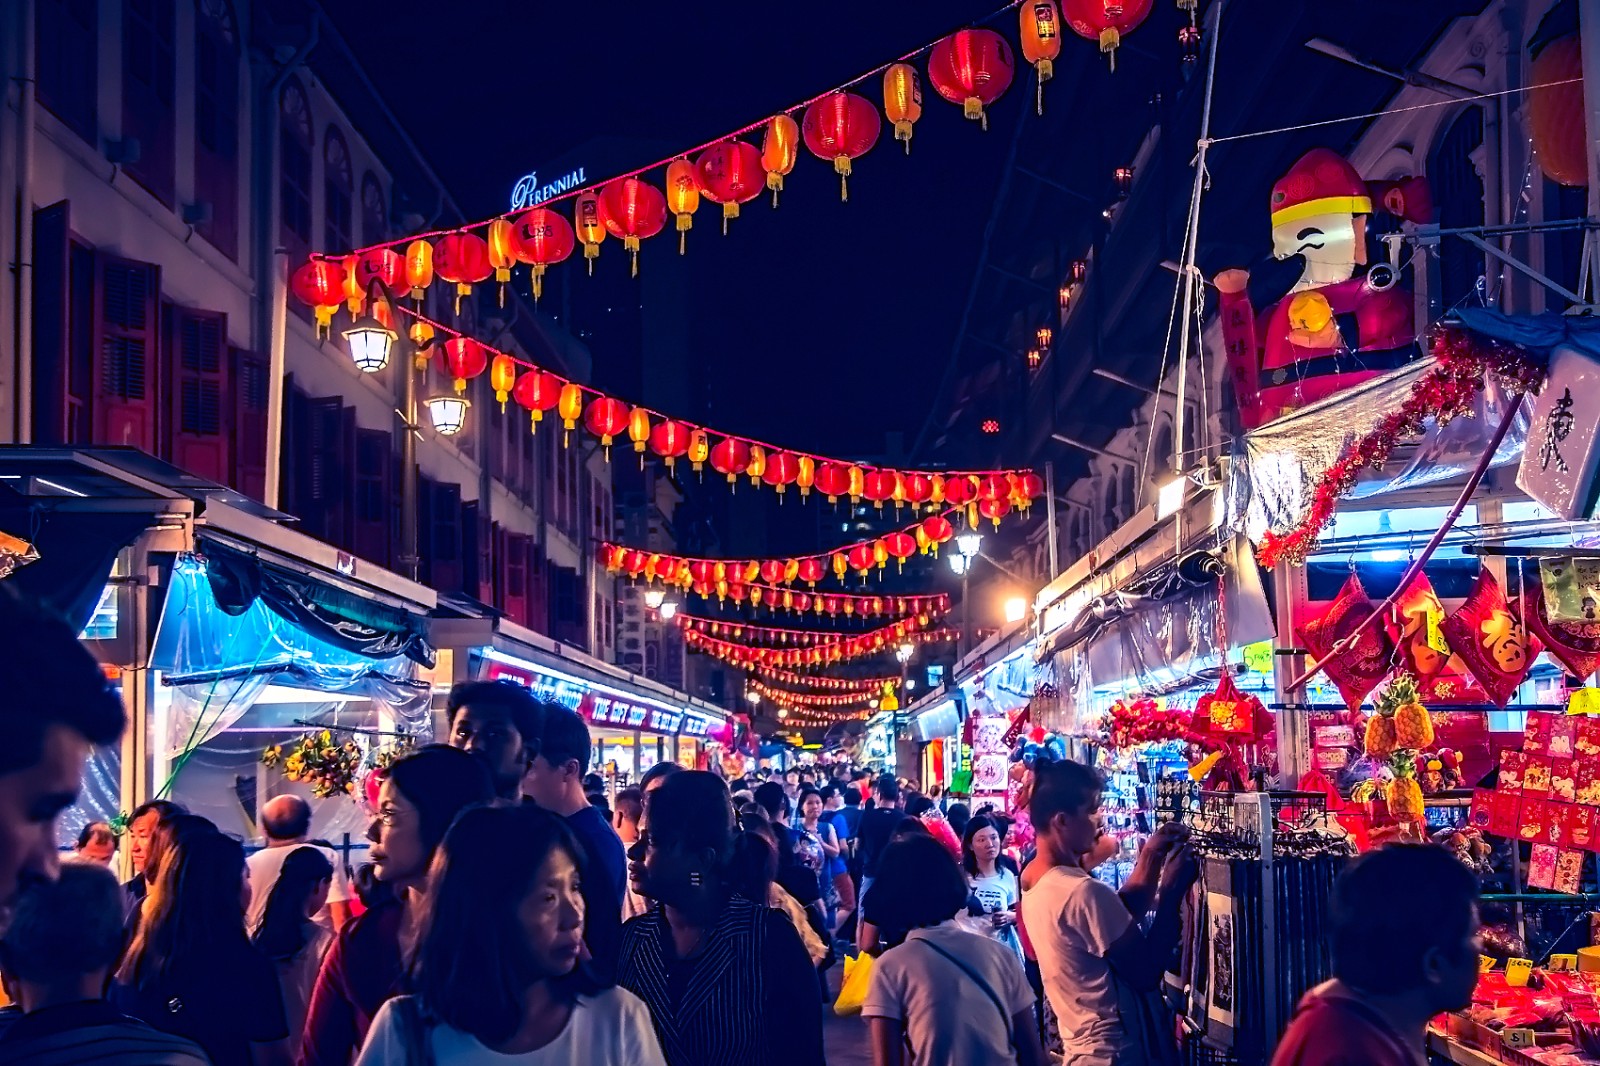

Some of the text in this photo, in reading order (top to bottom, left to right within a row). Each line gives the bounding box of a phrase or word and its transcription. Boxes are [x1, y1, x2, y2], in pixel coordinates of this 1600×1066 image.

[511, 168, 586, 212] PERENNIAL
[592, 697, 647, 726] THE GIFT SHOP
